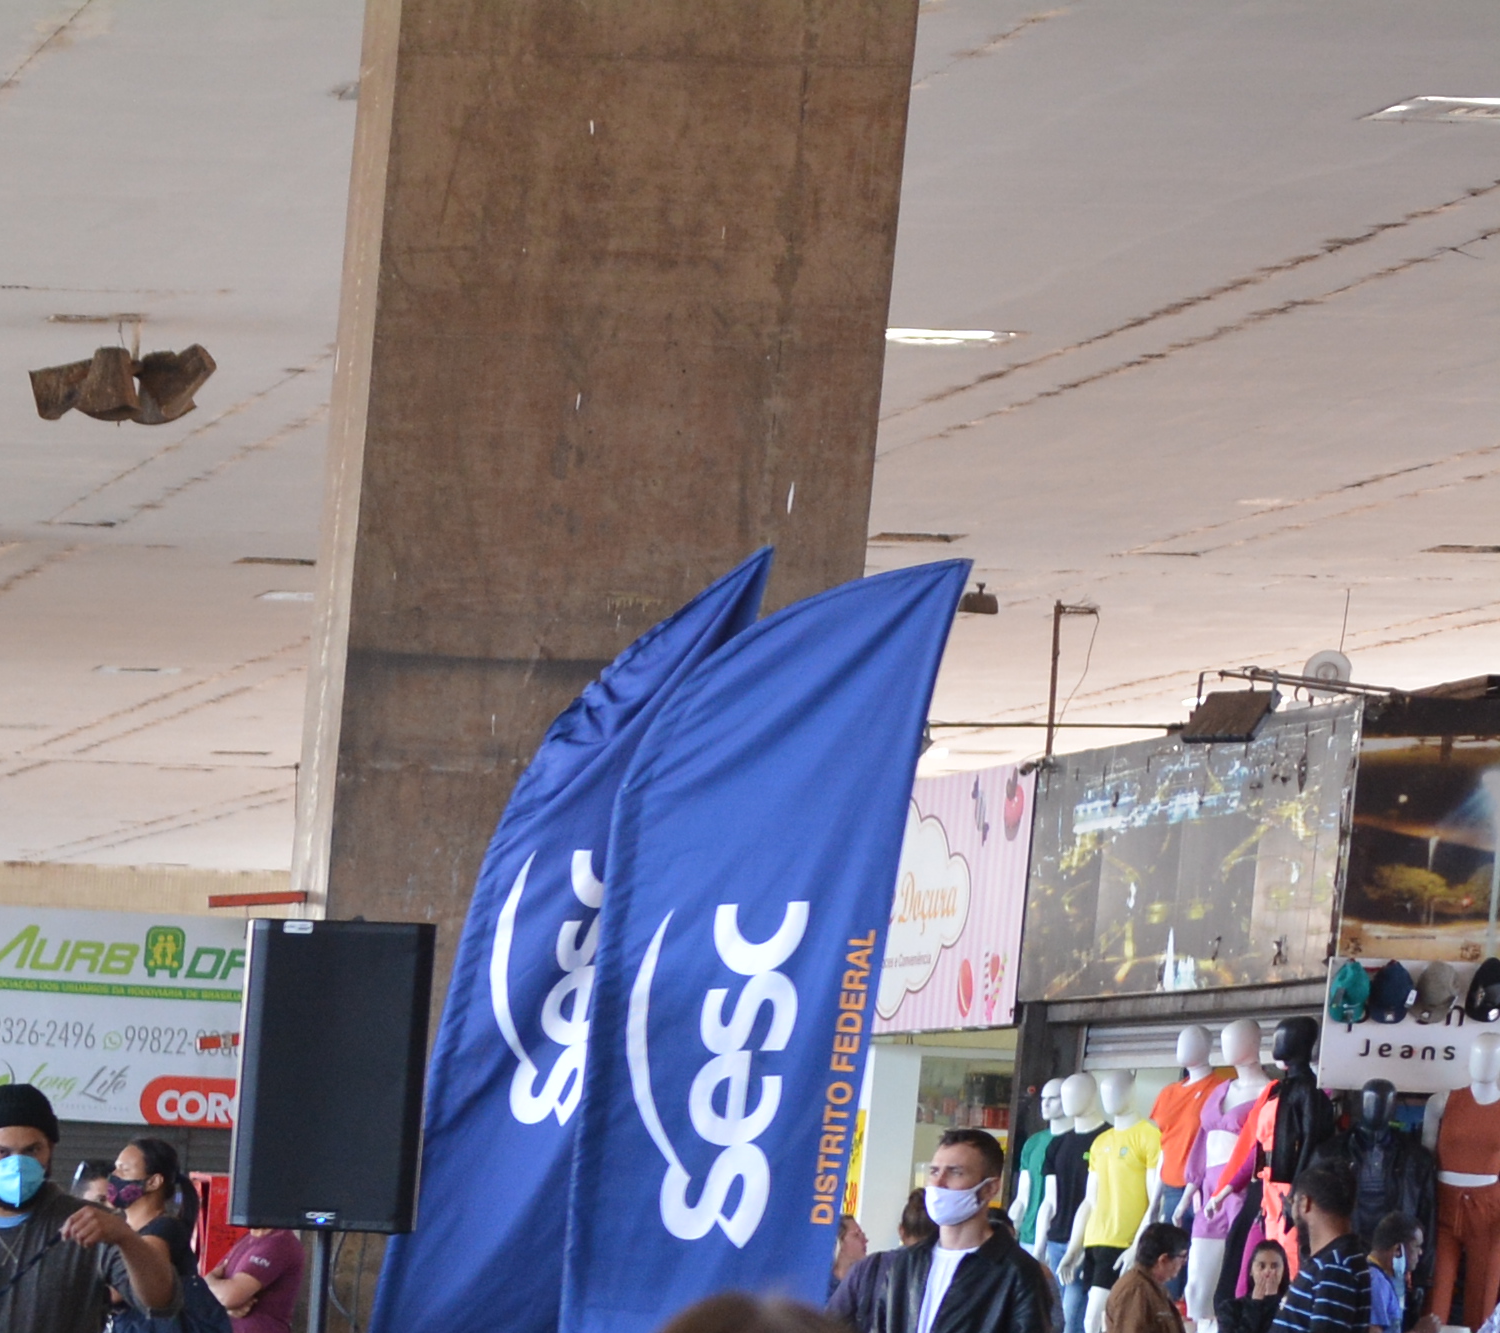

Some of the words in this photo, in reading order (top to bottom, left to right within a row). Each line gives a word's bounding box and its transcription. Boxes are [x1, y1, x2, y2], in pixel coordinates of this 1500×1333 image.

[830, 928, 877, 1073] FEDERAL
[80, 1065, 131, 1103] Life
[1359, 1038, 1456, 1061] Jeans
[809, 1080, 854, 1226] DISTRITO
